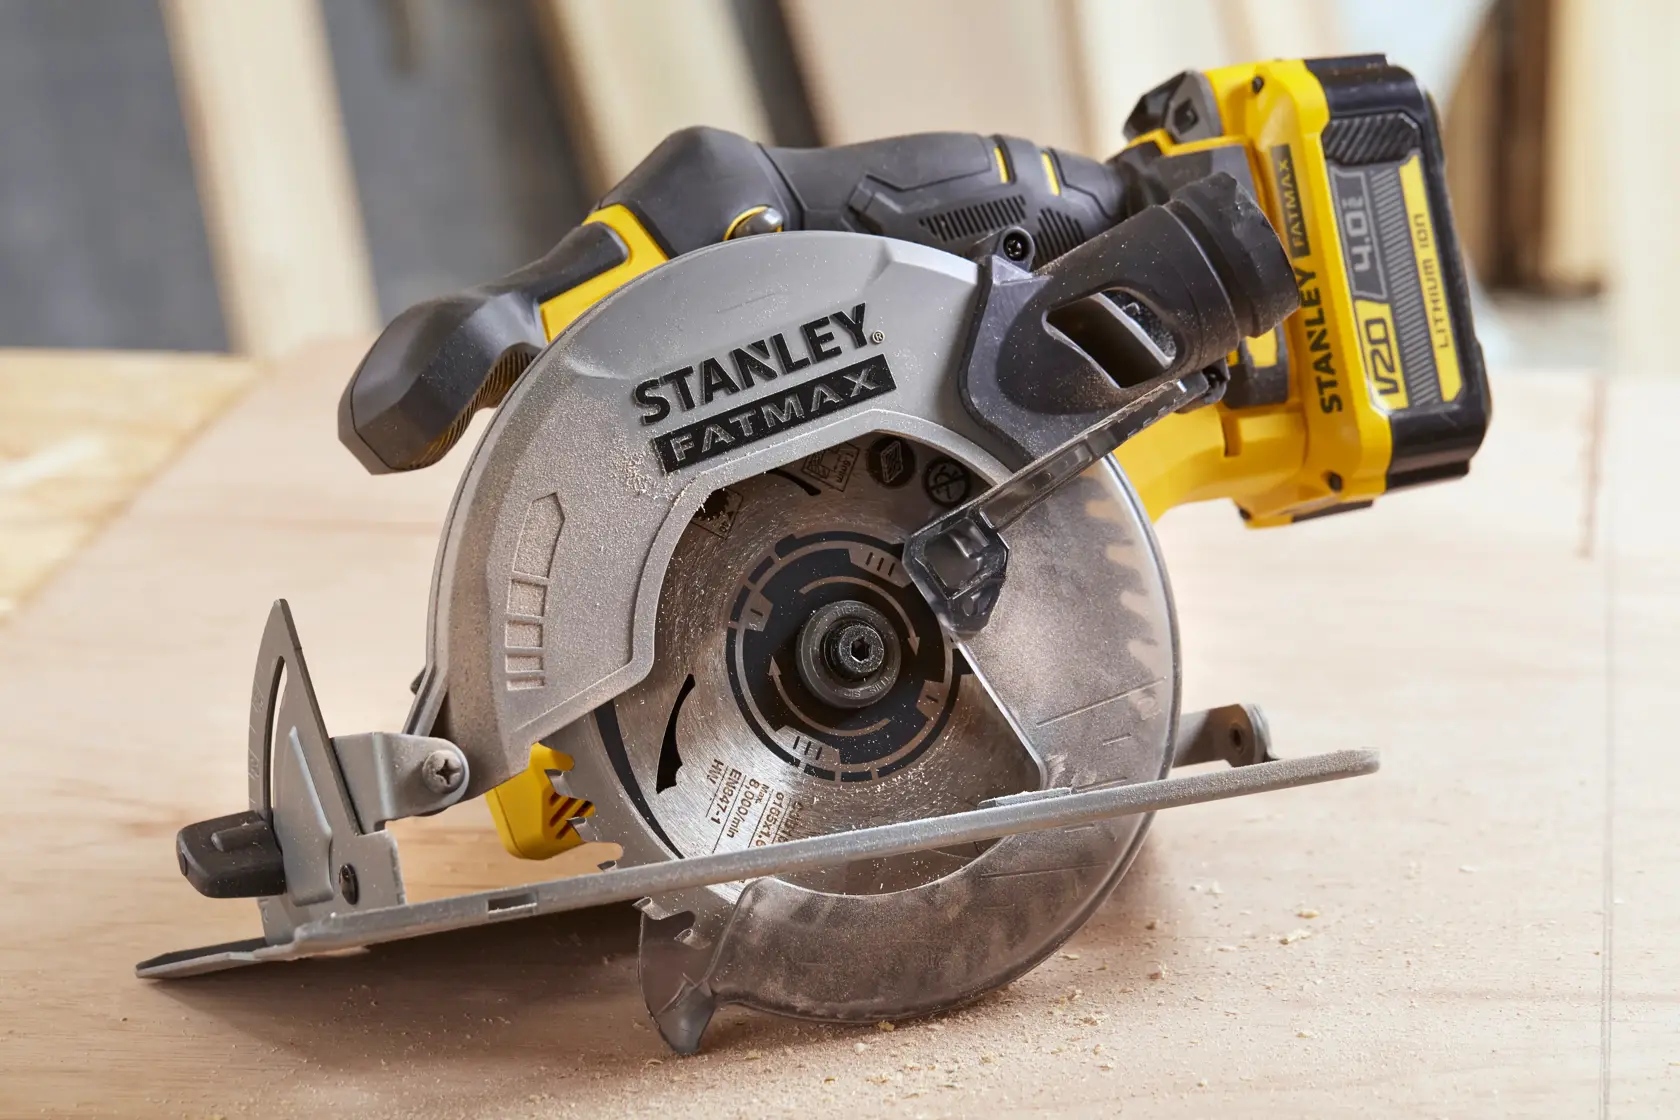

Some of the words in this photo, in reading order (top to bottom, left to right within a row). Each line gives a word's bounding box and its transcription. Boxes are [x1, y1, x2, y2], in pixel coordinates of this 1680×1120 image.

[1279, 159, 1305, 248] FATMAX
[1295, 266, 1343, 414] STANLEY
[1422, 259, 1449, 348] LITHIUM
[633, 302, 868, 425] STANLEY
[1365, 317, 1400, 396] V20
[669, 366, 880, 462] FATMAX
[710, 768, 743, 825] EN847-1
[726, 778, 760, 838] 8,000/min
